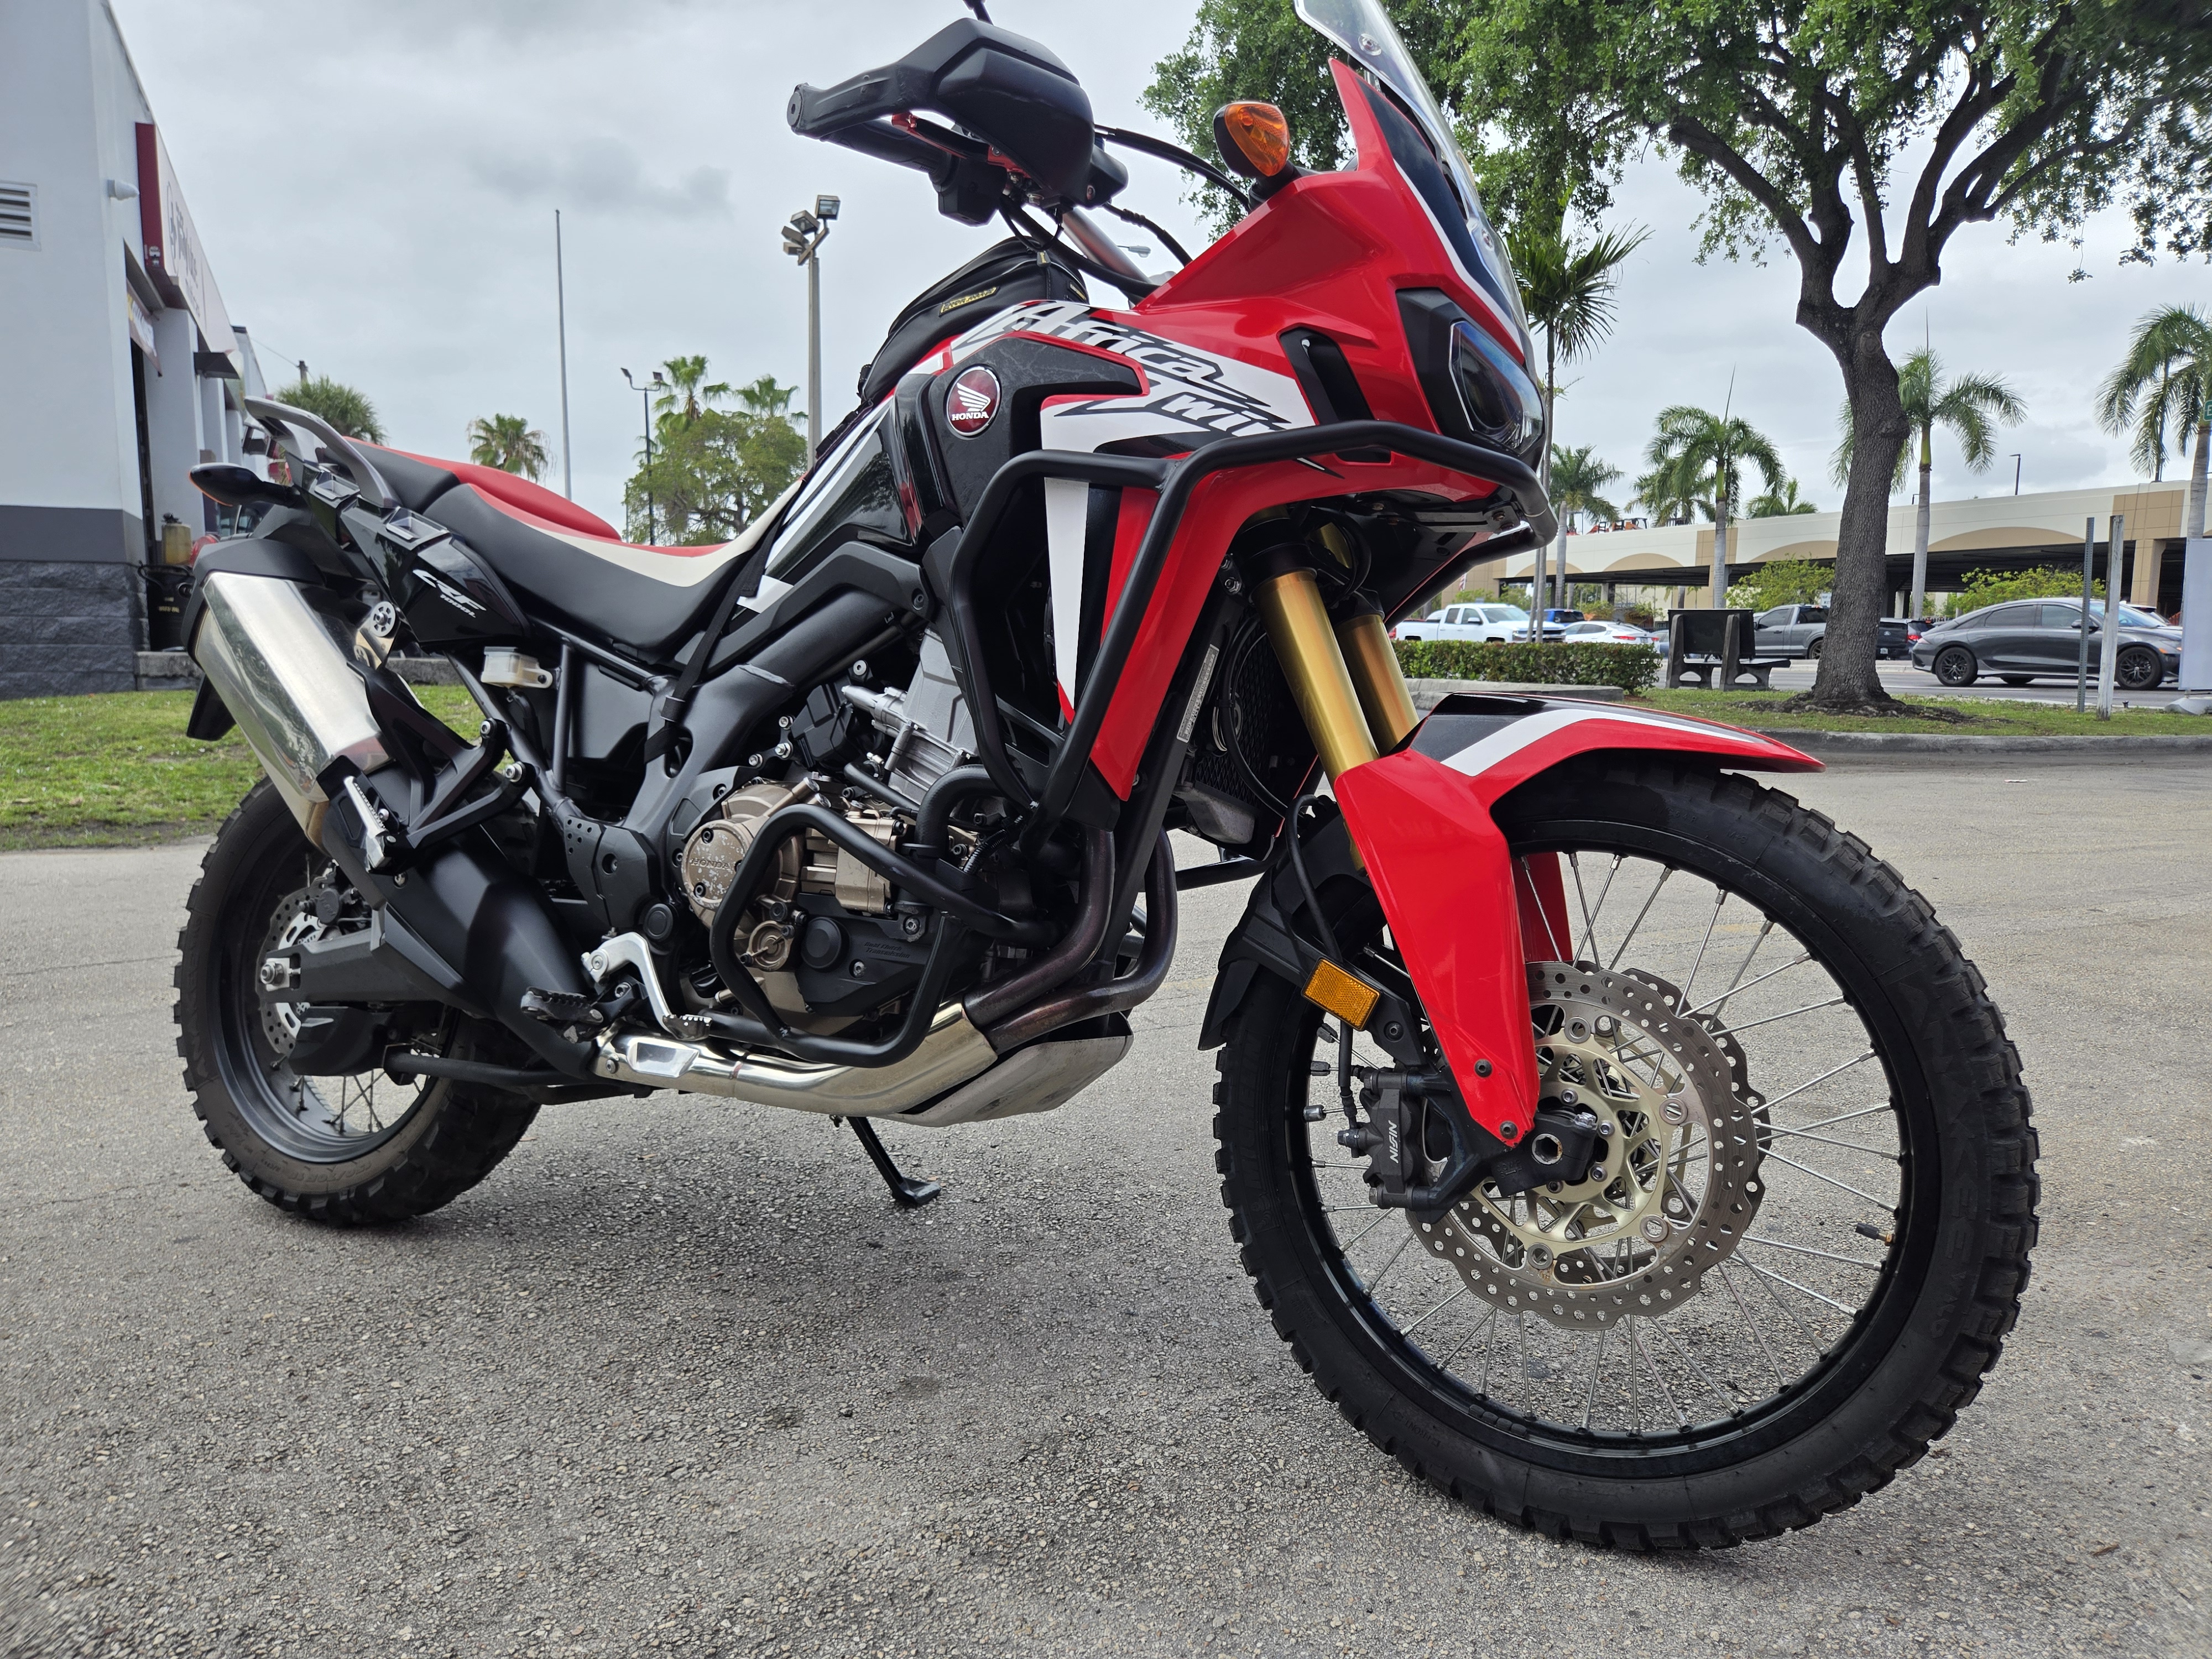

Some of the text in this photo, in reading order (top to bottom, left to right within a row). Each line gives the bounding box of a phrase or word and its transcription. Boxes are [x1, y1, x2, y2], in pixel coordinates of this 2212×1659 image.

[1012, 300, 1248, 399] Africa
[951, 411, 989, 421] HONDA
[413, 569, 487, 611] CRF
[440, 593, 476, 618] 1000L
[690, 858, 732, 871] HONDA
[865, 947, 911, 959] Transmission
[1237, 1031, 1263, 1190] MICHELIN
[1388, 1120, 1399, 1164] NISSIN
[1405, 1420, 1431, 1442] FRONT
